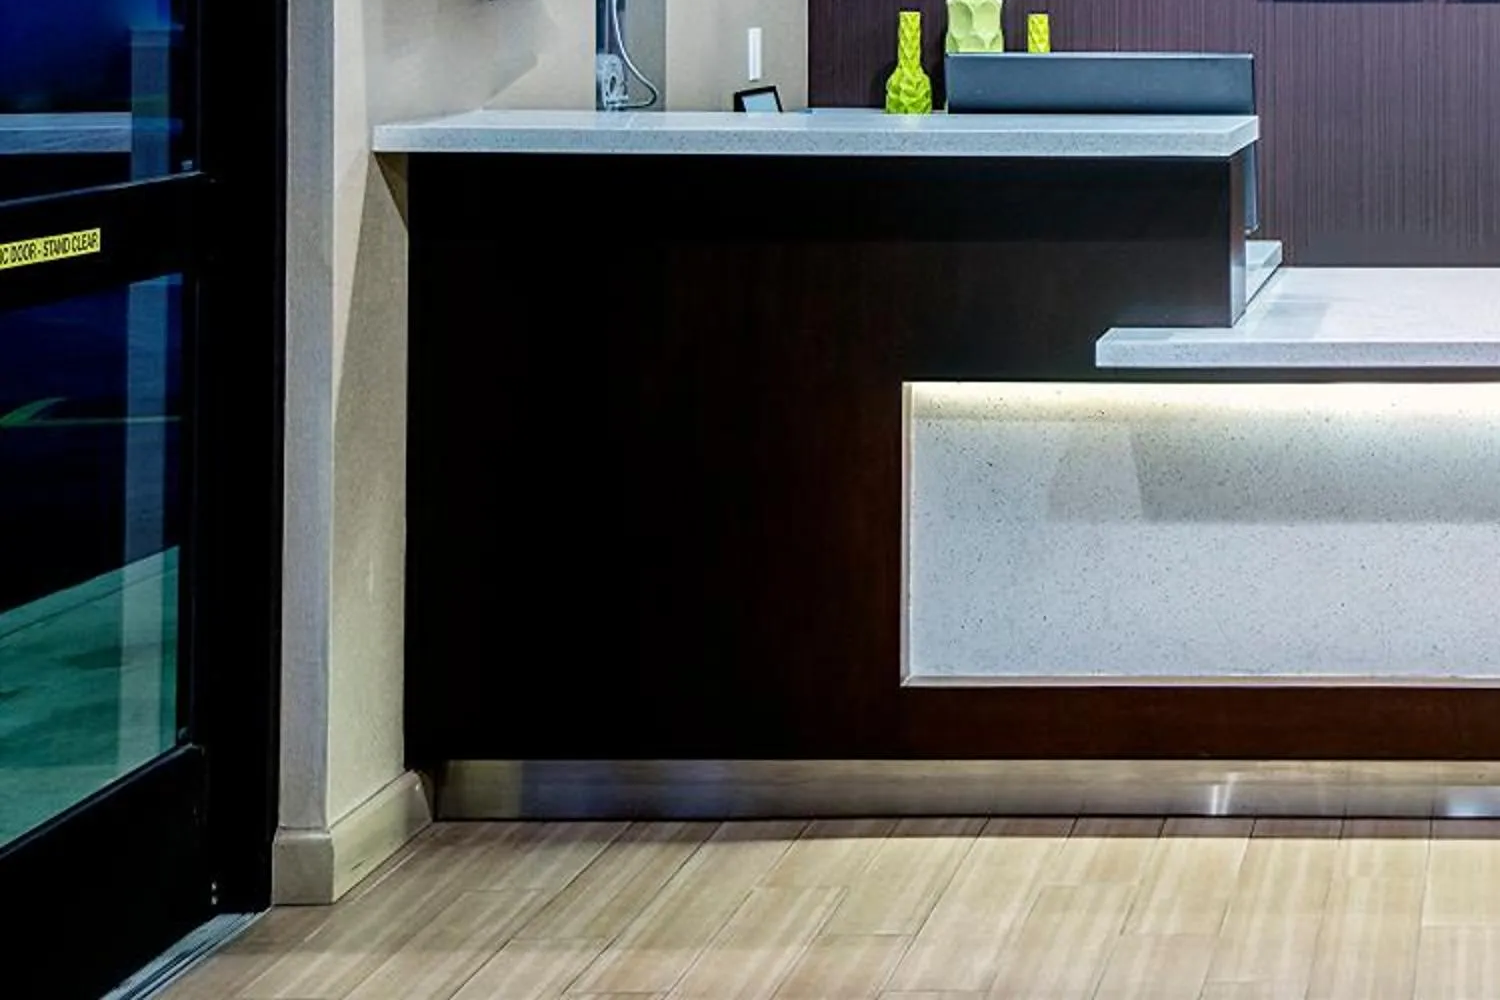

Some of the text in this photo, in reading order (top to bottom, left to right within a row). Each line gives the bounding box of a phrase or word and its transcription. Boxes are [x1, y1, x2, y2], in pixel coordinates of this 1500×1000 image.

[10, 242, 37, 263] DOOR
[43, 237, 70, 257] STAND
[71, 231, 98, 253] CLEAR
